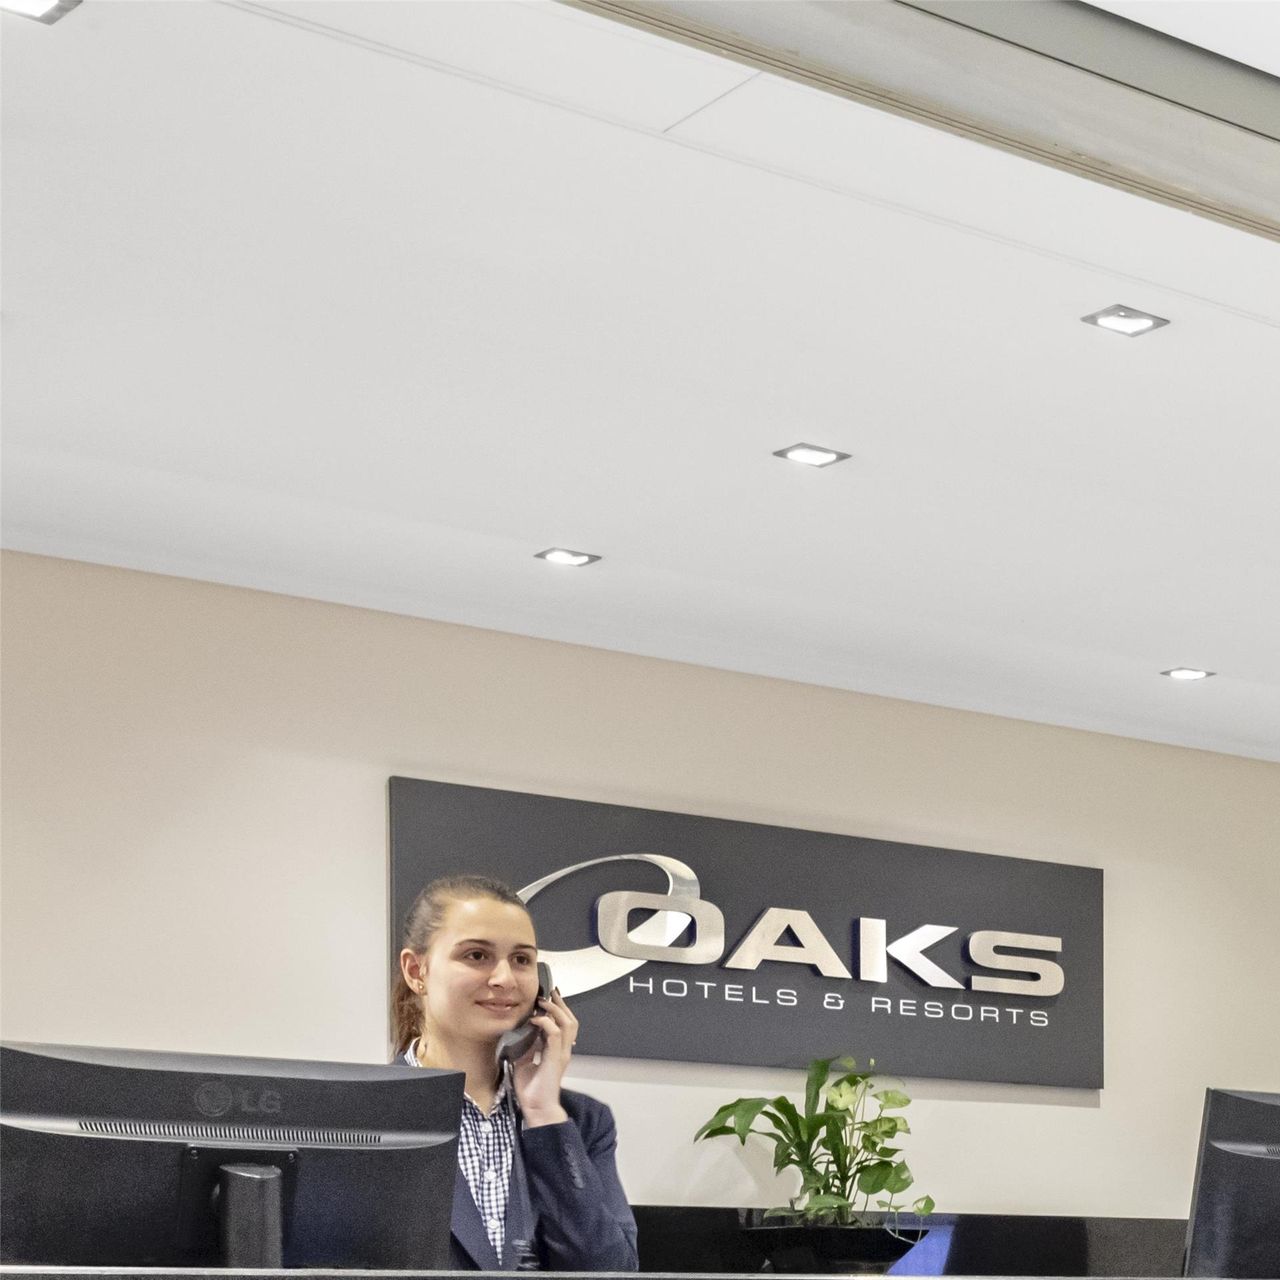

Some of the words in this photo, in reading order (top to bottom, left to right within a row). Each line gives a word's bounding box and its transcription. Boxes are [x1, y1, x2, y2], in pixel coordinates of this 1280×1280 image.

[597, 890, 1066, 998] OAKS
[629, 976, 798, 1007] HOTELS
[823, 992, 845, 1010] &
[871, 997, 1049, 1028] RESORTS
[239, 1089, 281, 1113] LG
